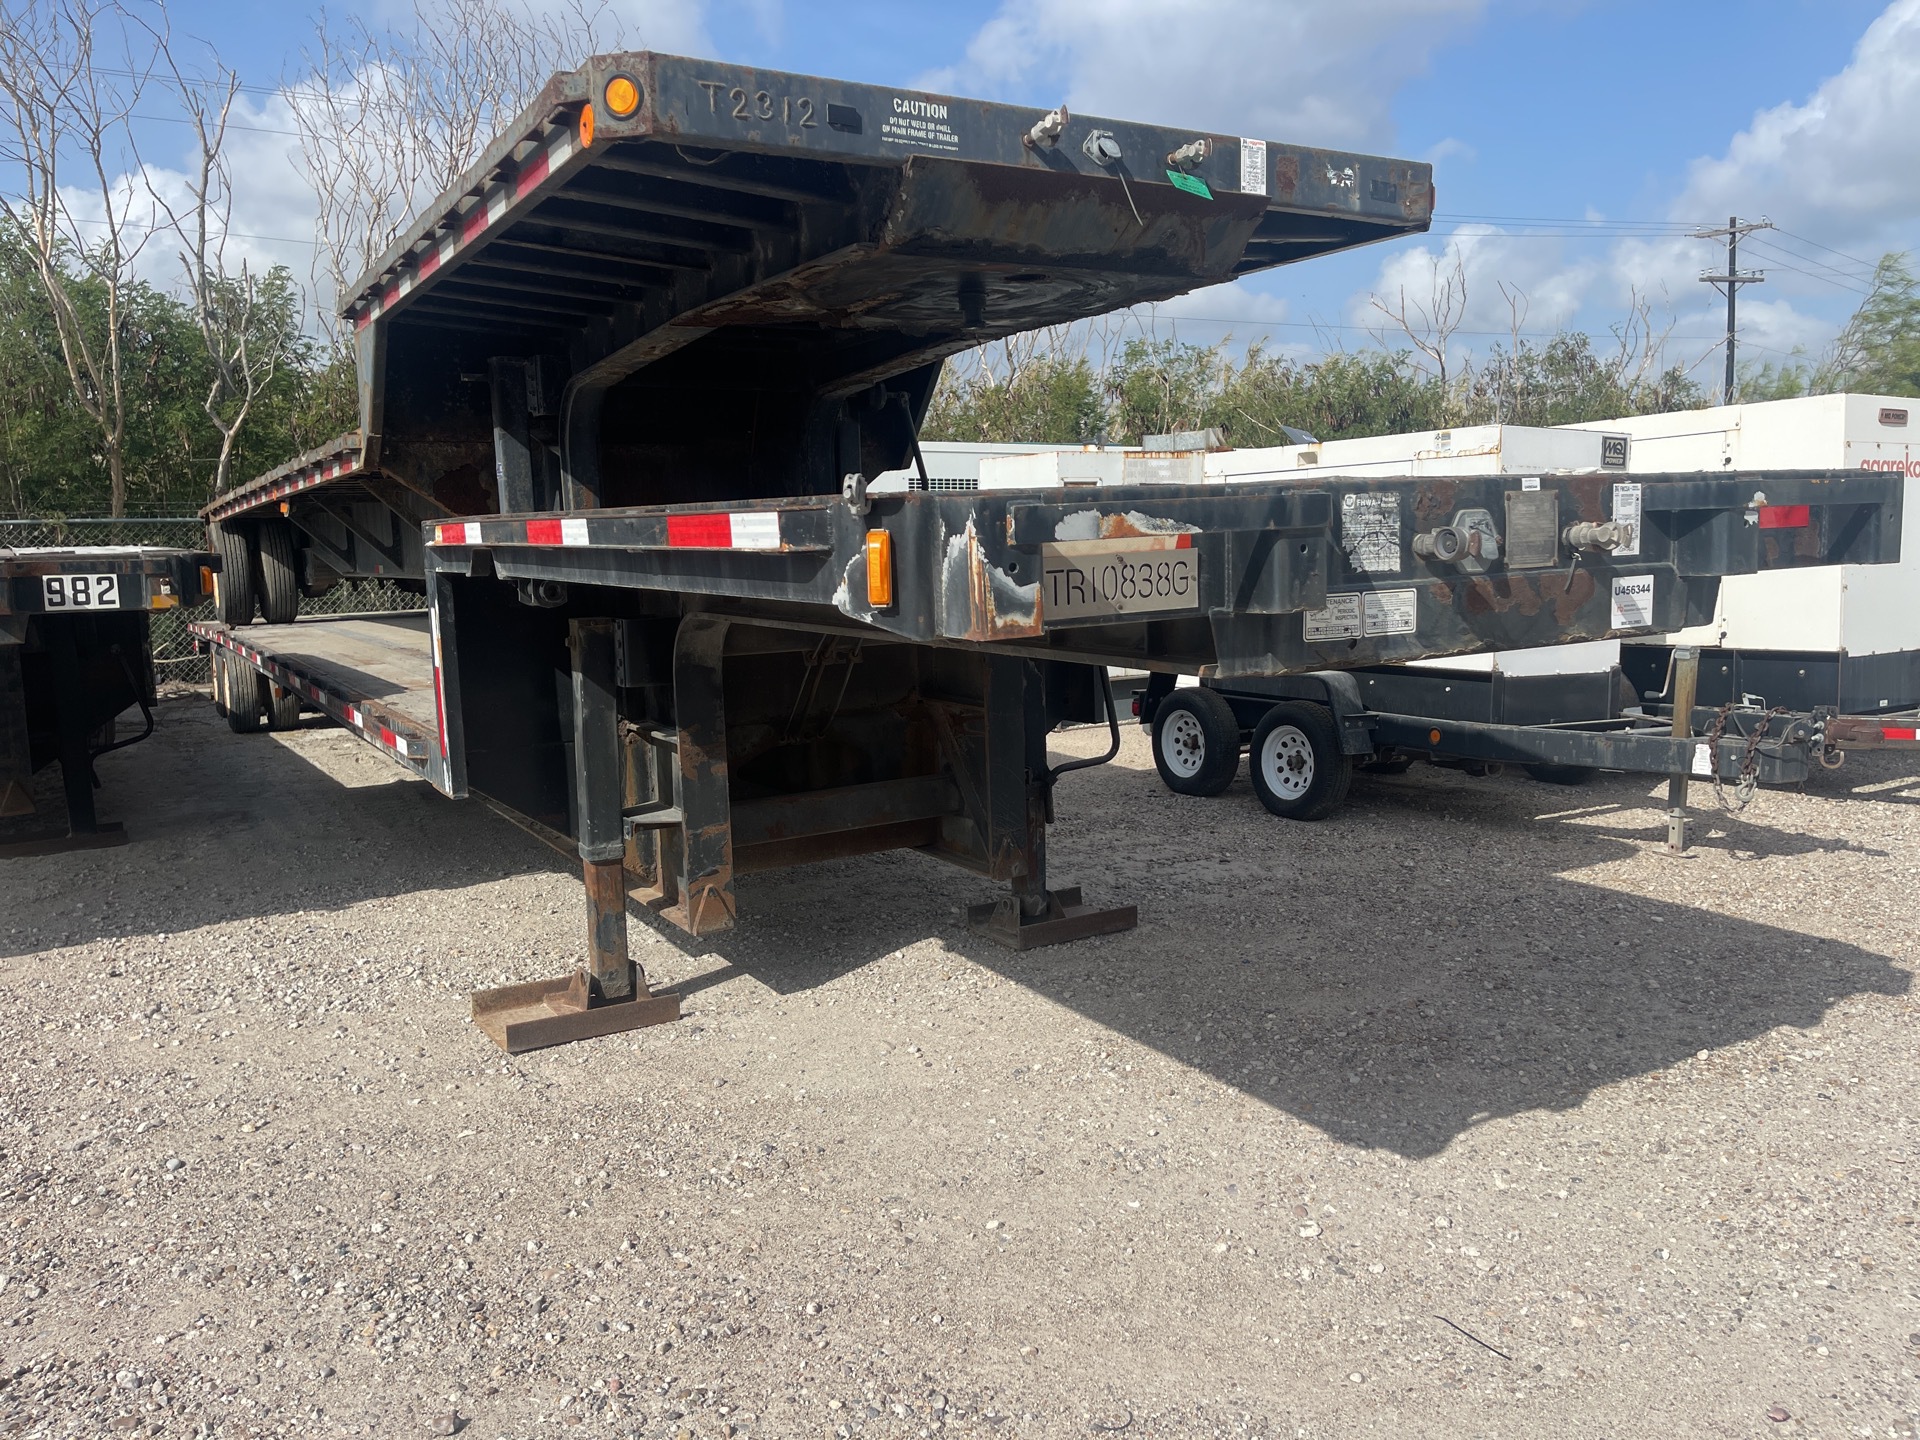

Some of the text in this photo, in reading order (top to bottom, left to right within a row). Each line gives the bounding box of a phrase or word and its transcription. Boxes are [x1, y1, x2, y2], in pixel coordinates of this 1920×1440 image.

[698, 80, 818, 128] T2312
[893, 97, 948, 119] CAUTION
[889, 116, 898, 125] DO
[899, 117, 910, 127] NOT
[911, 119, 927, 130] WELD
[927, 122, 936, 131] OR
[891, 126, 907, 136] MAIN
[907, 128, 927, 139] FRAME
[927, 131, 936, 140] OF
[936, 132, 959, 144] TRAILER
[1605, 441, 1624, 456] MQ
[46, 576, 117, 607] 982
[1614, 583, 1651, 596] U456344
